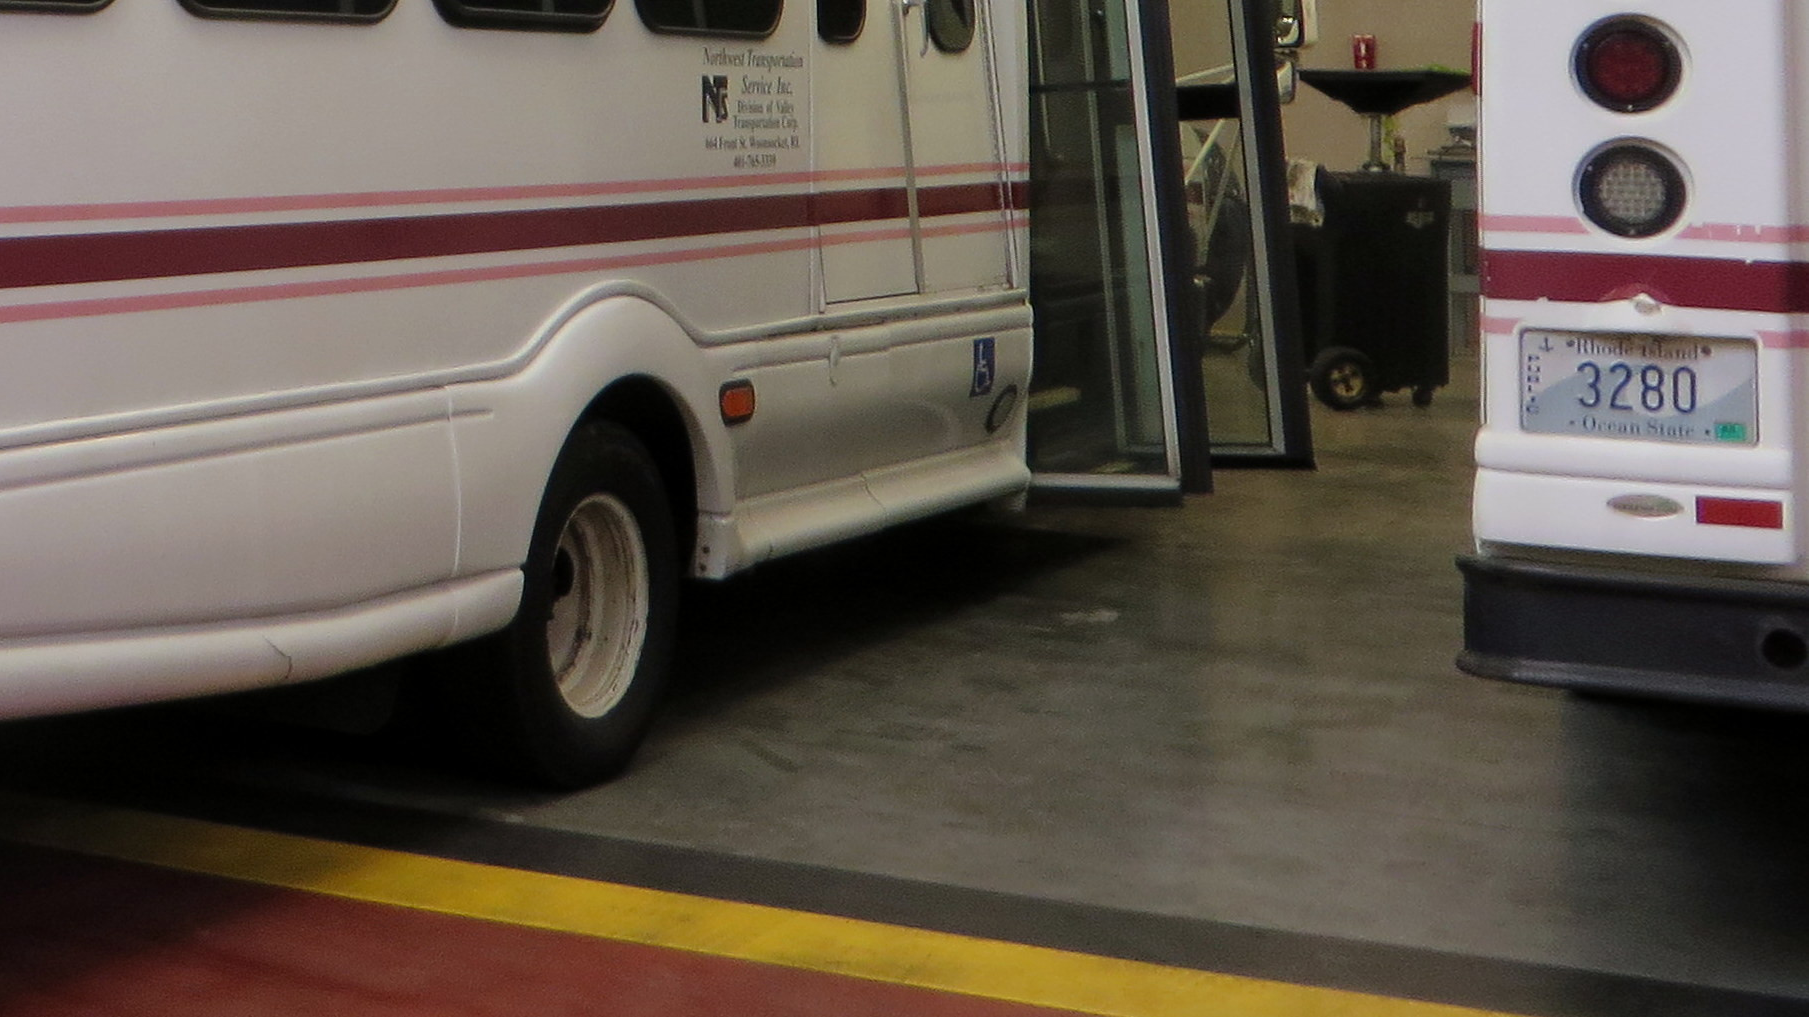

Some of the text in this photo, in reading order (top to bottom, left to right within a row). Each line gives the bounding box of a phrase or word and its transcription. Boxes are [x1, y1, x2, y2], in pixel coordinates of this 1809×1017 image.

[703, 47, 803, 72] Northwest Transportation
[741, 75, 793, 95] Service Inc.
[737, 101, 763, 113] Division
[734, 115, 780, 131] Transportation
[1575, 337, 1632, 356] Rhode
[1576, 360, 1698, 414] 3280
[1581, 414, 1640, 435] Ocean
[1646, 418, 1694, 438] State
